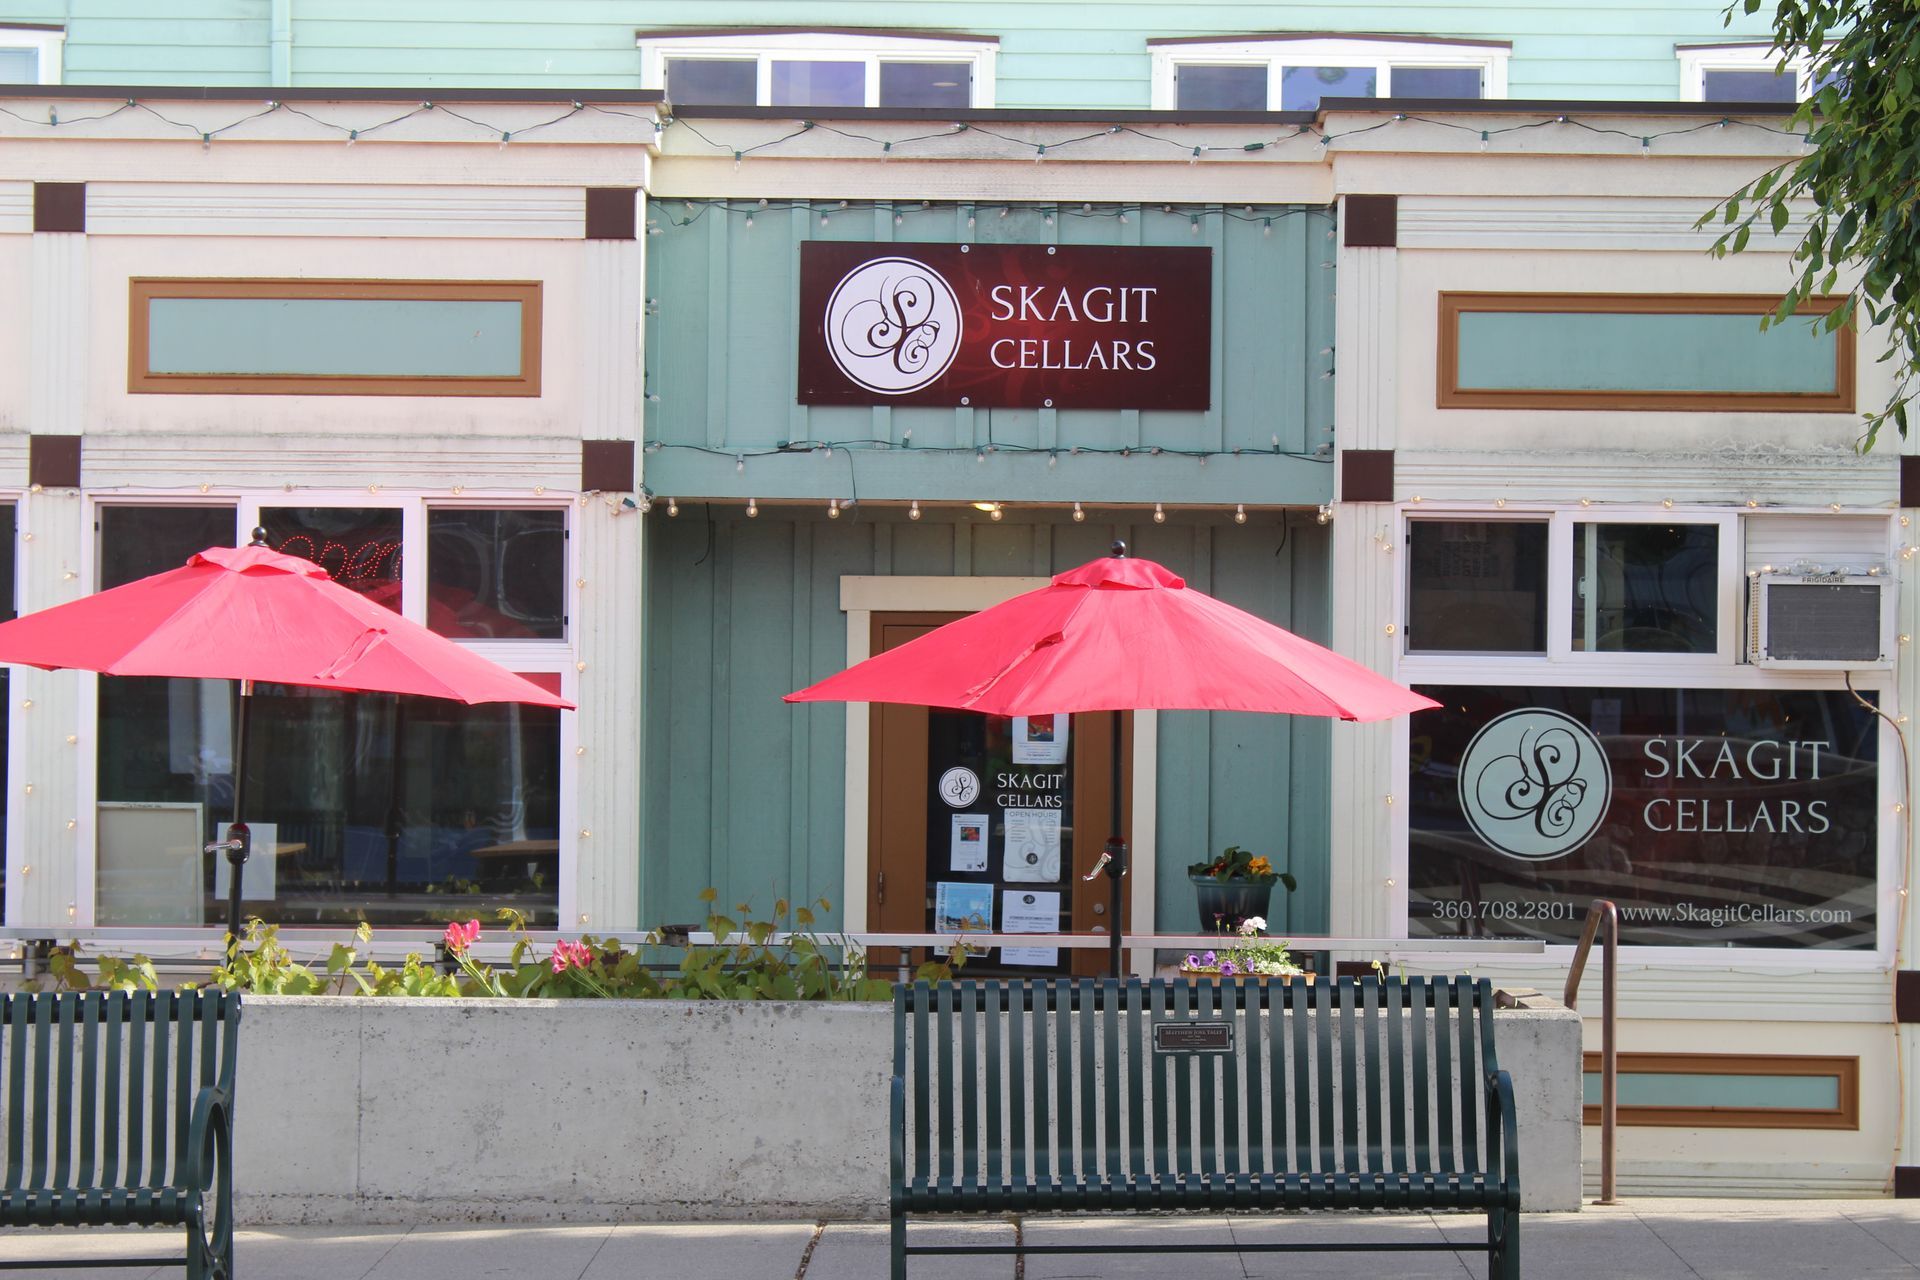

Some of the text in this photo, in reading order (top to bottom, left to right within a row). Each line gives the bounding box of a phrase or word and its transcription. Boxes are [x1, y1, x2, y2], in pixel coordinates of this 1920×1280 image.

[990, 284, 1158, 324] SKAGIT
[989, 337, 1158, 372] CELLARS
[1801, 576, 1846, 584] FRIGIDAIRE
[1643, 737, 1831, 781] SKAGIT
[996, 773, 1064, 790] SKAGIT
[996, 793, 1063, 808] CELLARS
[1642, 797, 1831, 834] CELLARS
[1431, 900, 1853, 929] 360.708.2801 www.SkagitCellars.com
